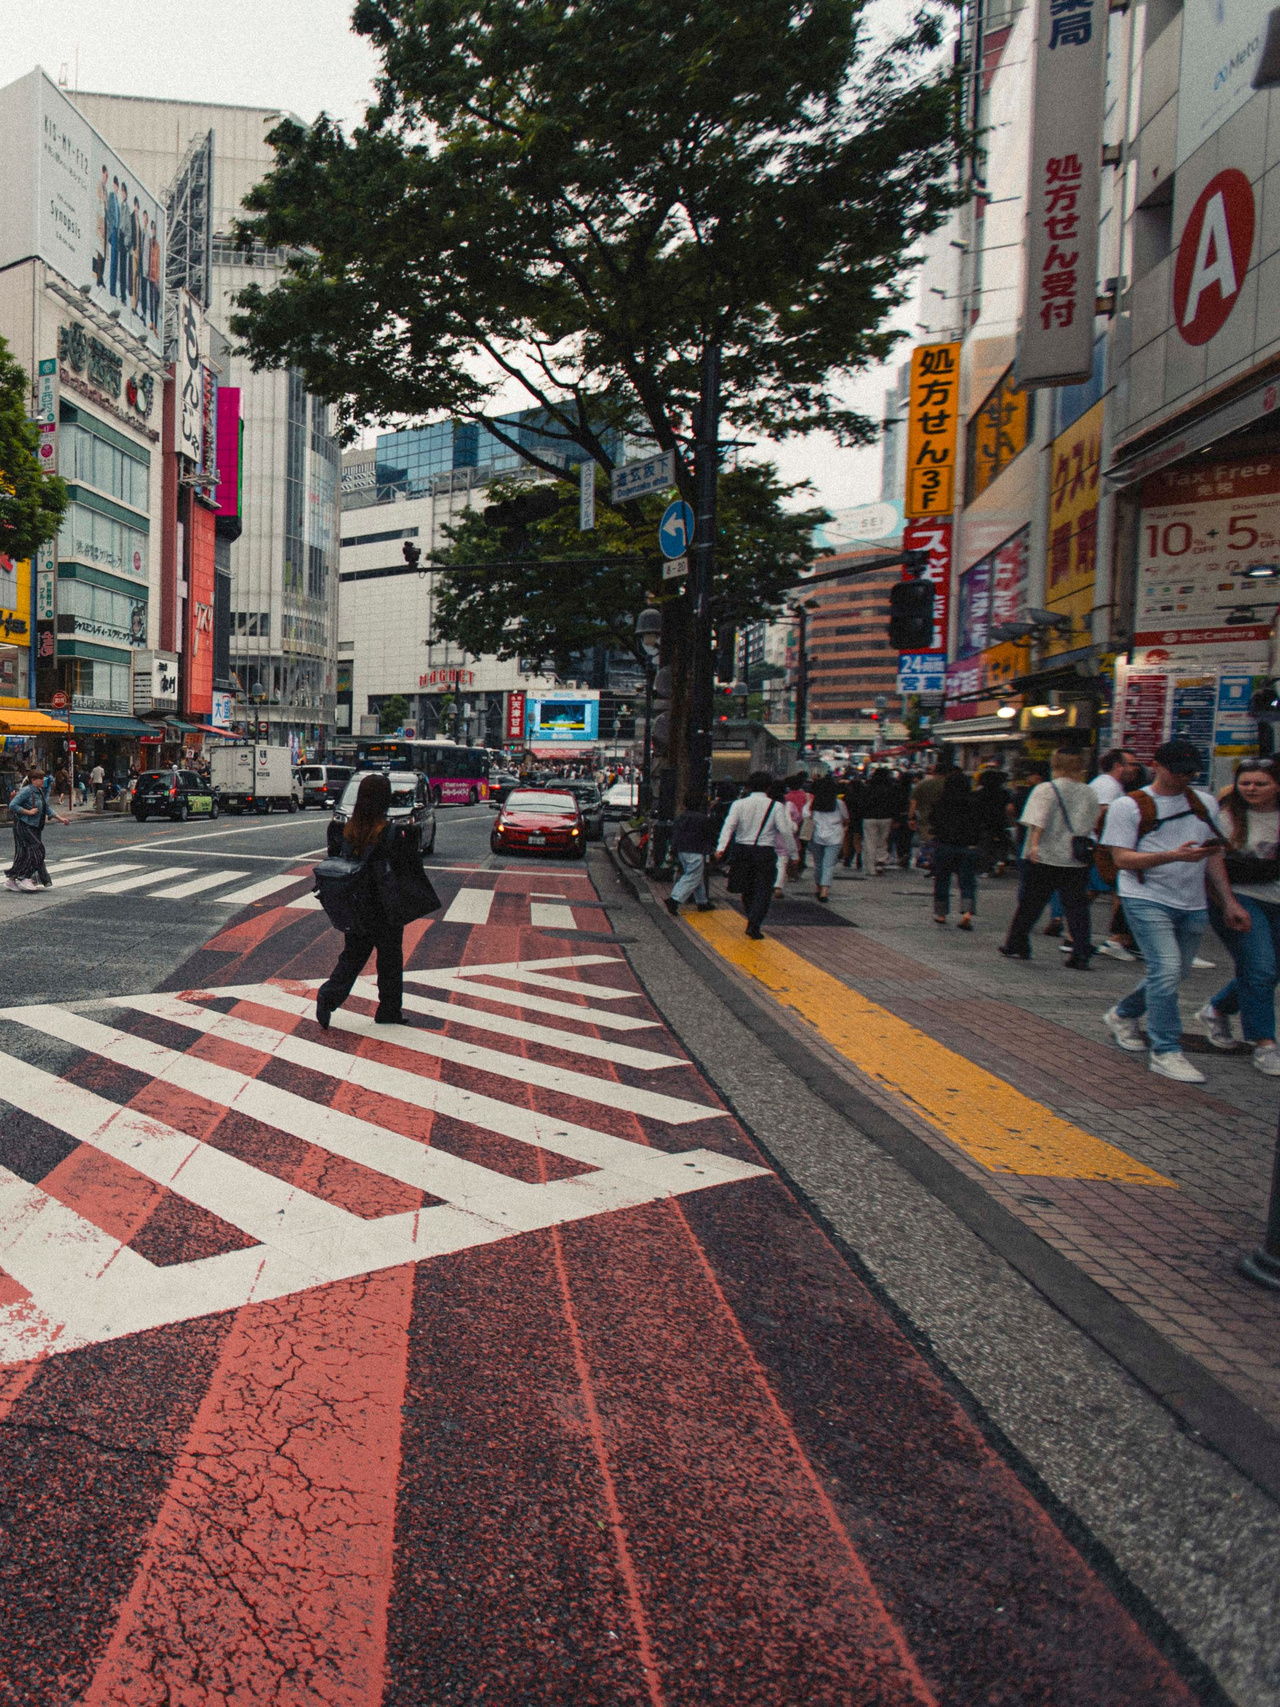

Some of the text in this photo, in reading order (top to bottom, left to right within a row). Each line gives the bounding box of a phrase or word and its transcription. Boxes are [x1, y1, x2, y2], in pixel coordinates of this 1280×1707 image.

[1040, 153, 1083, 330] 処方せん受付
[916, 347, 956, 511] 処方せん 3F
[616, 456, 669, 488] 道玄坂下
[1166, 462, 1271, 486] Tax Free
[583, 463, 594, 529] スクランブル式
[1145, 521, 1194, 558] 10
[1227, 514, 1259, 550] 5
[666, 560, 687, 576] 8-20
[1180, 630, 1256, 642] BicCamera
[418, 669, 475, 688] MAGNET
[901, 655, 922, 673] 24
[510, 702, 521, 736] 天津甘栗
